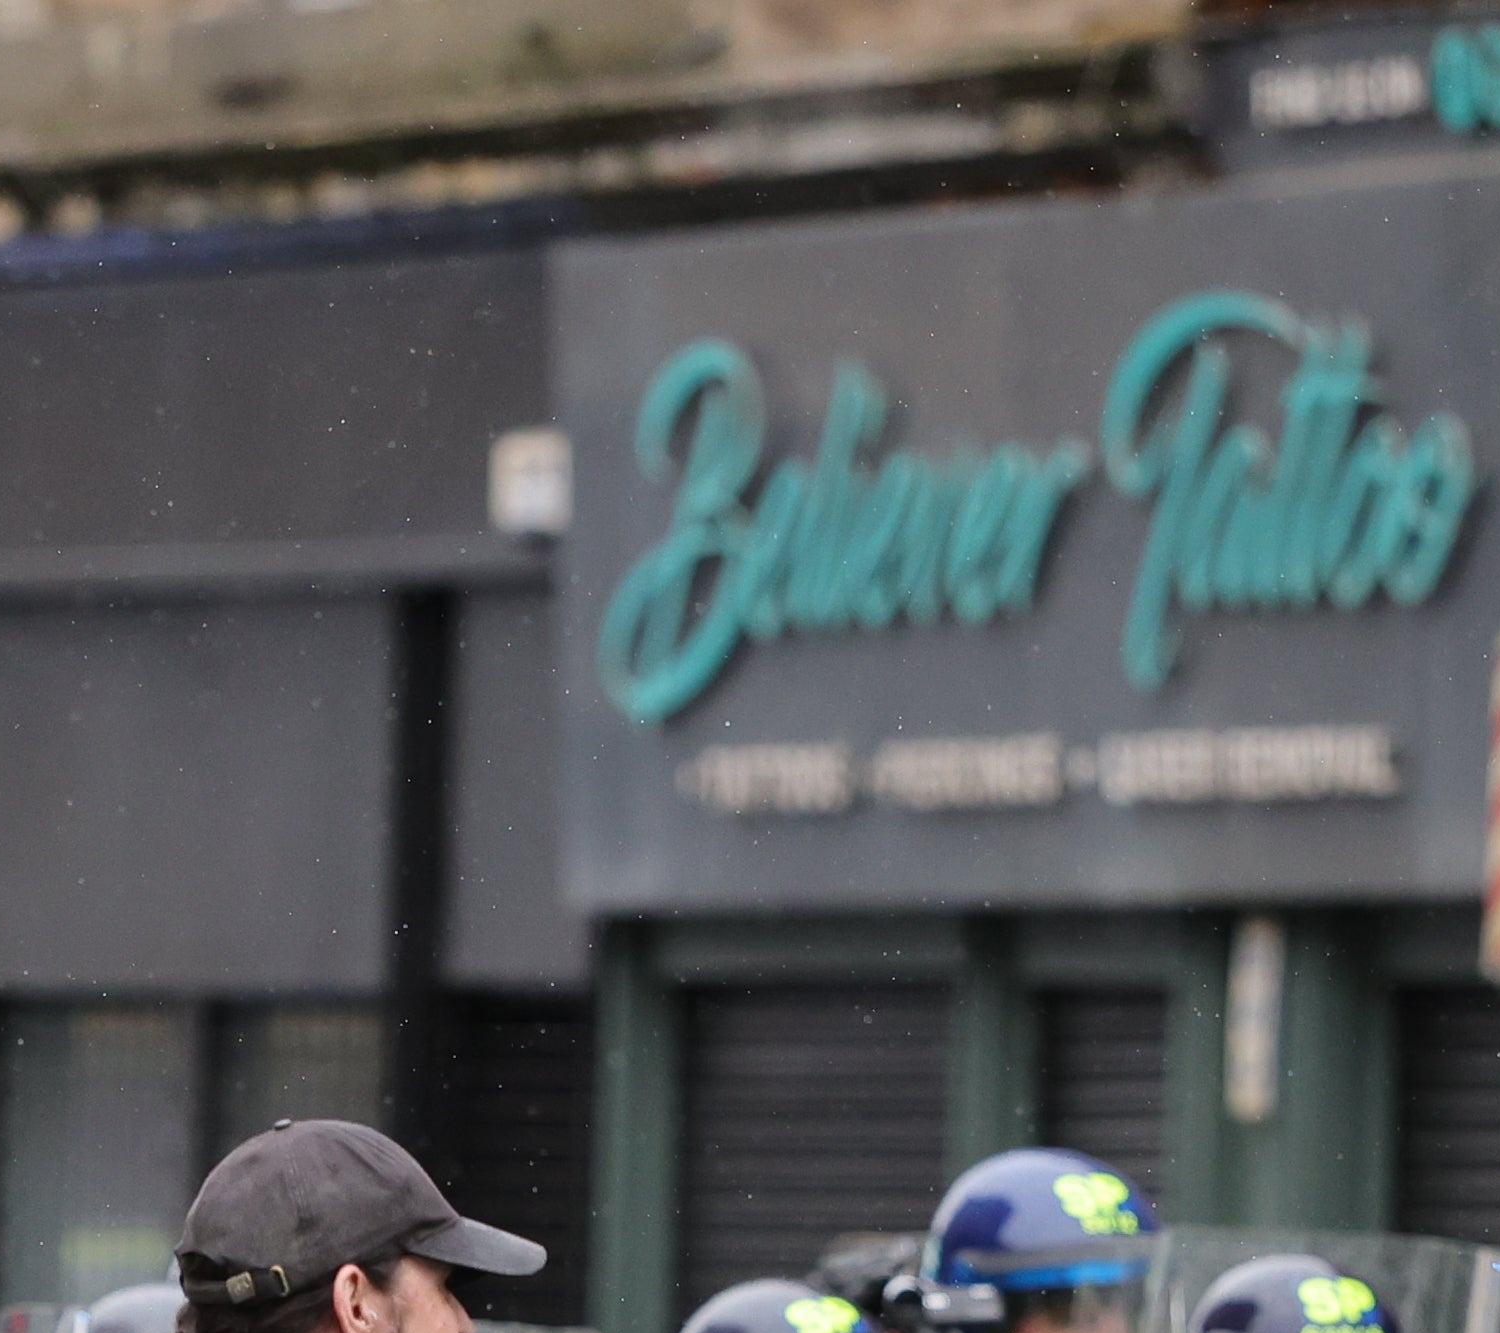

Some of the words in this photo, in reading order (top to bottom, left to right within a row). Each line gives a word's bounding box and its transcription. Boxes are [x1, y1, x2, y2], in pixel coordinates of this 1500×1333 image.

[600, 339, 1087, 724] Believer
[1102, 290, 1477, 691] Tattoo
[1052, 1172, 1129, 1218] SP
[1297, 1276, 1376, 1324] SP
